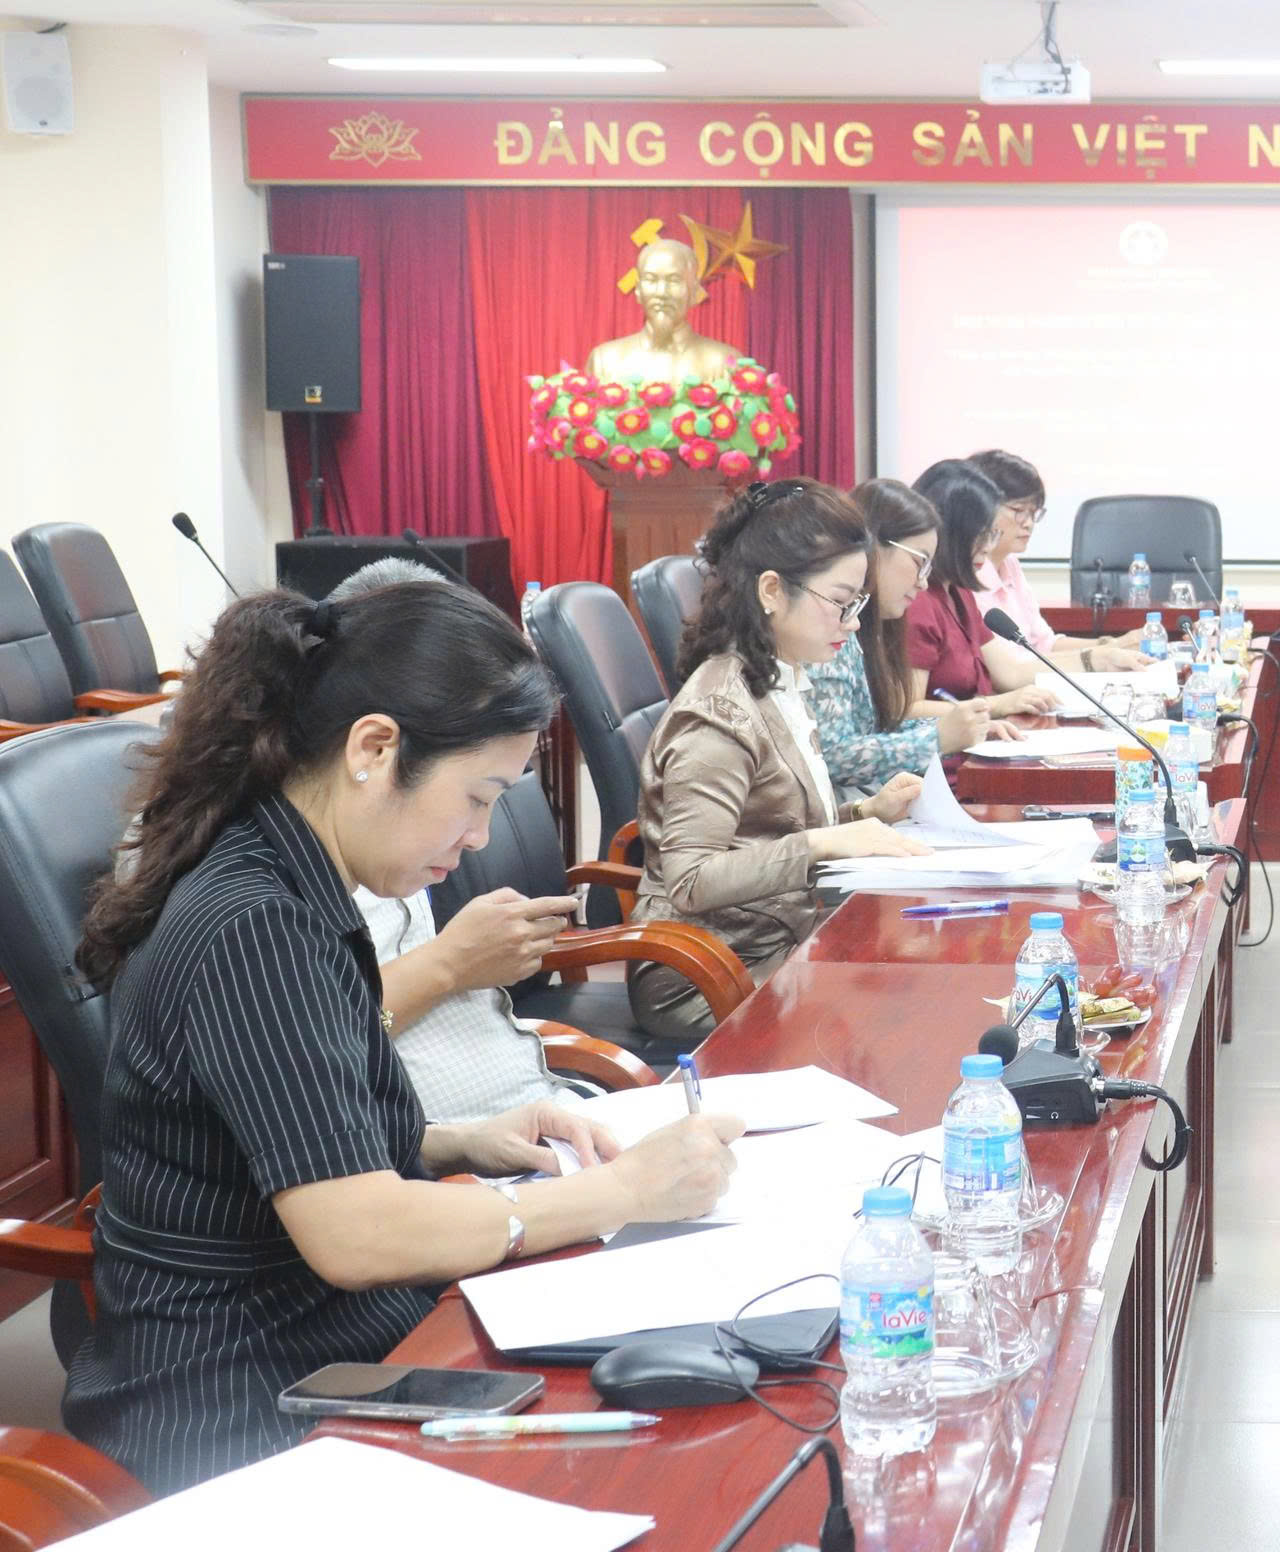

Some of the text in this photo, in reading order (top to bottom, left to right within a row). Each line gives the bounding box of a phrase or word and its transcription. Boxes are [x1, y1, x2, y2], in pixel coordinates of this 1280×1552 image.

[493, 107, 667, 167] ĐẢNG
[699, 112, 874, 177] CỘNG
[912, 110, 1034, 167] SẢN
[1072, 114, 1209, 179] VIỆT
